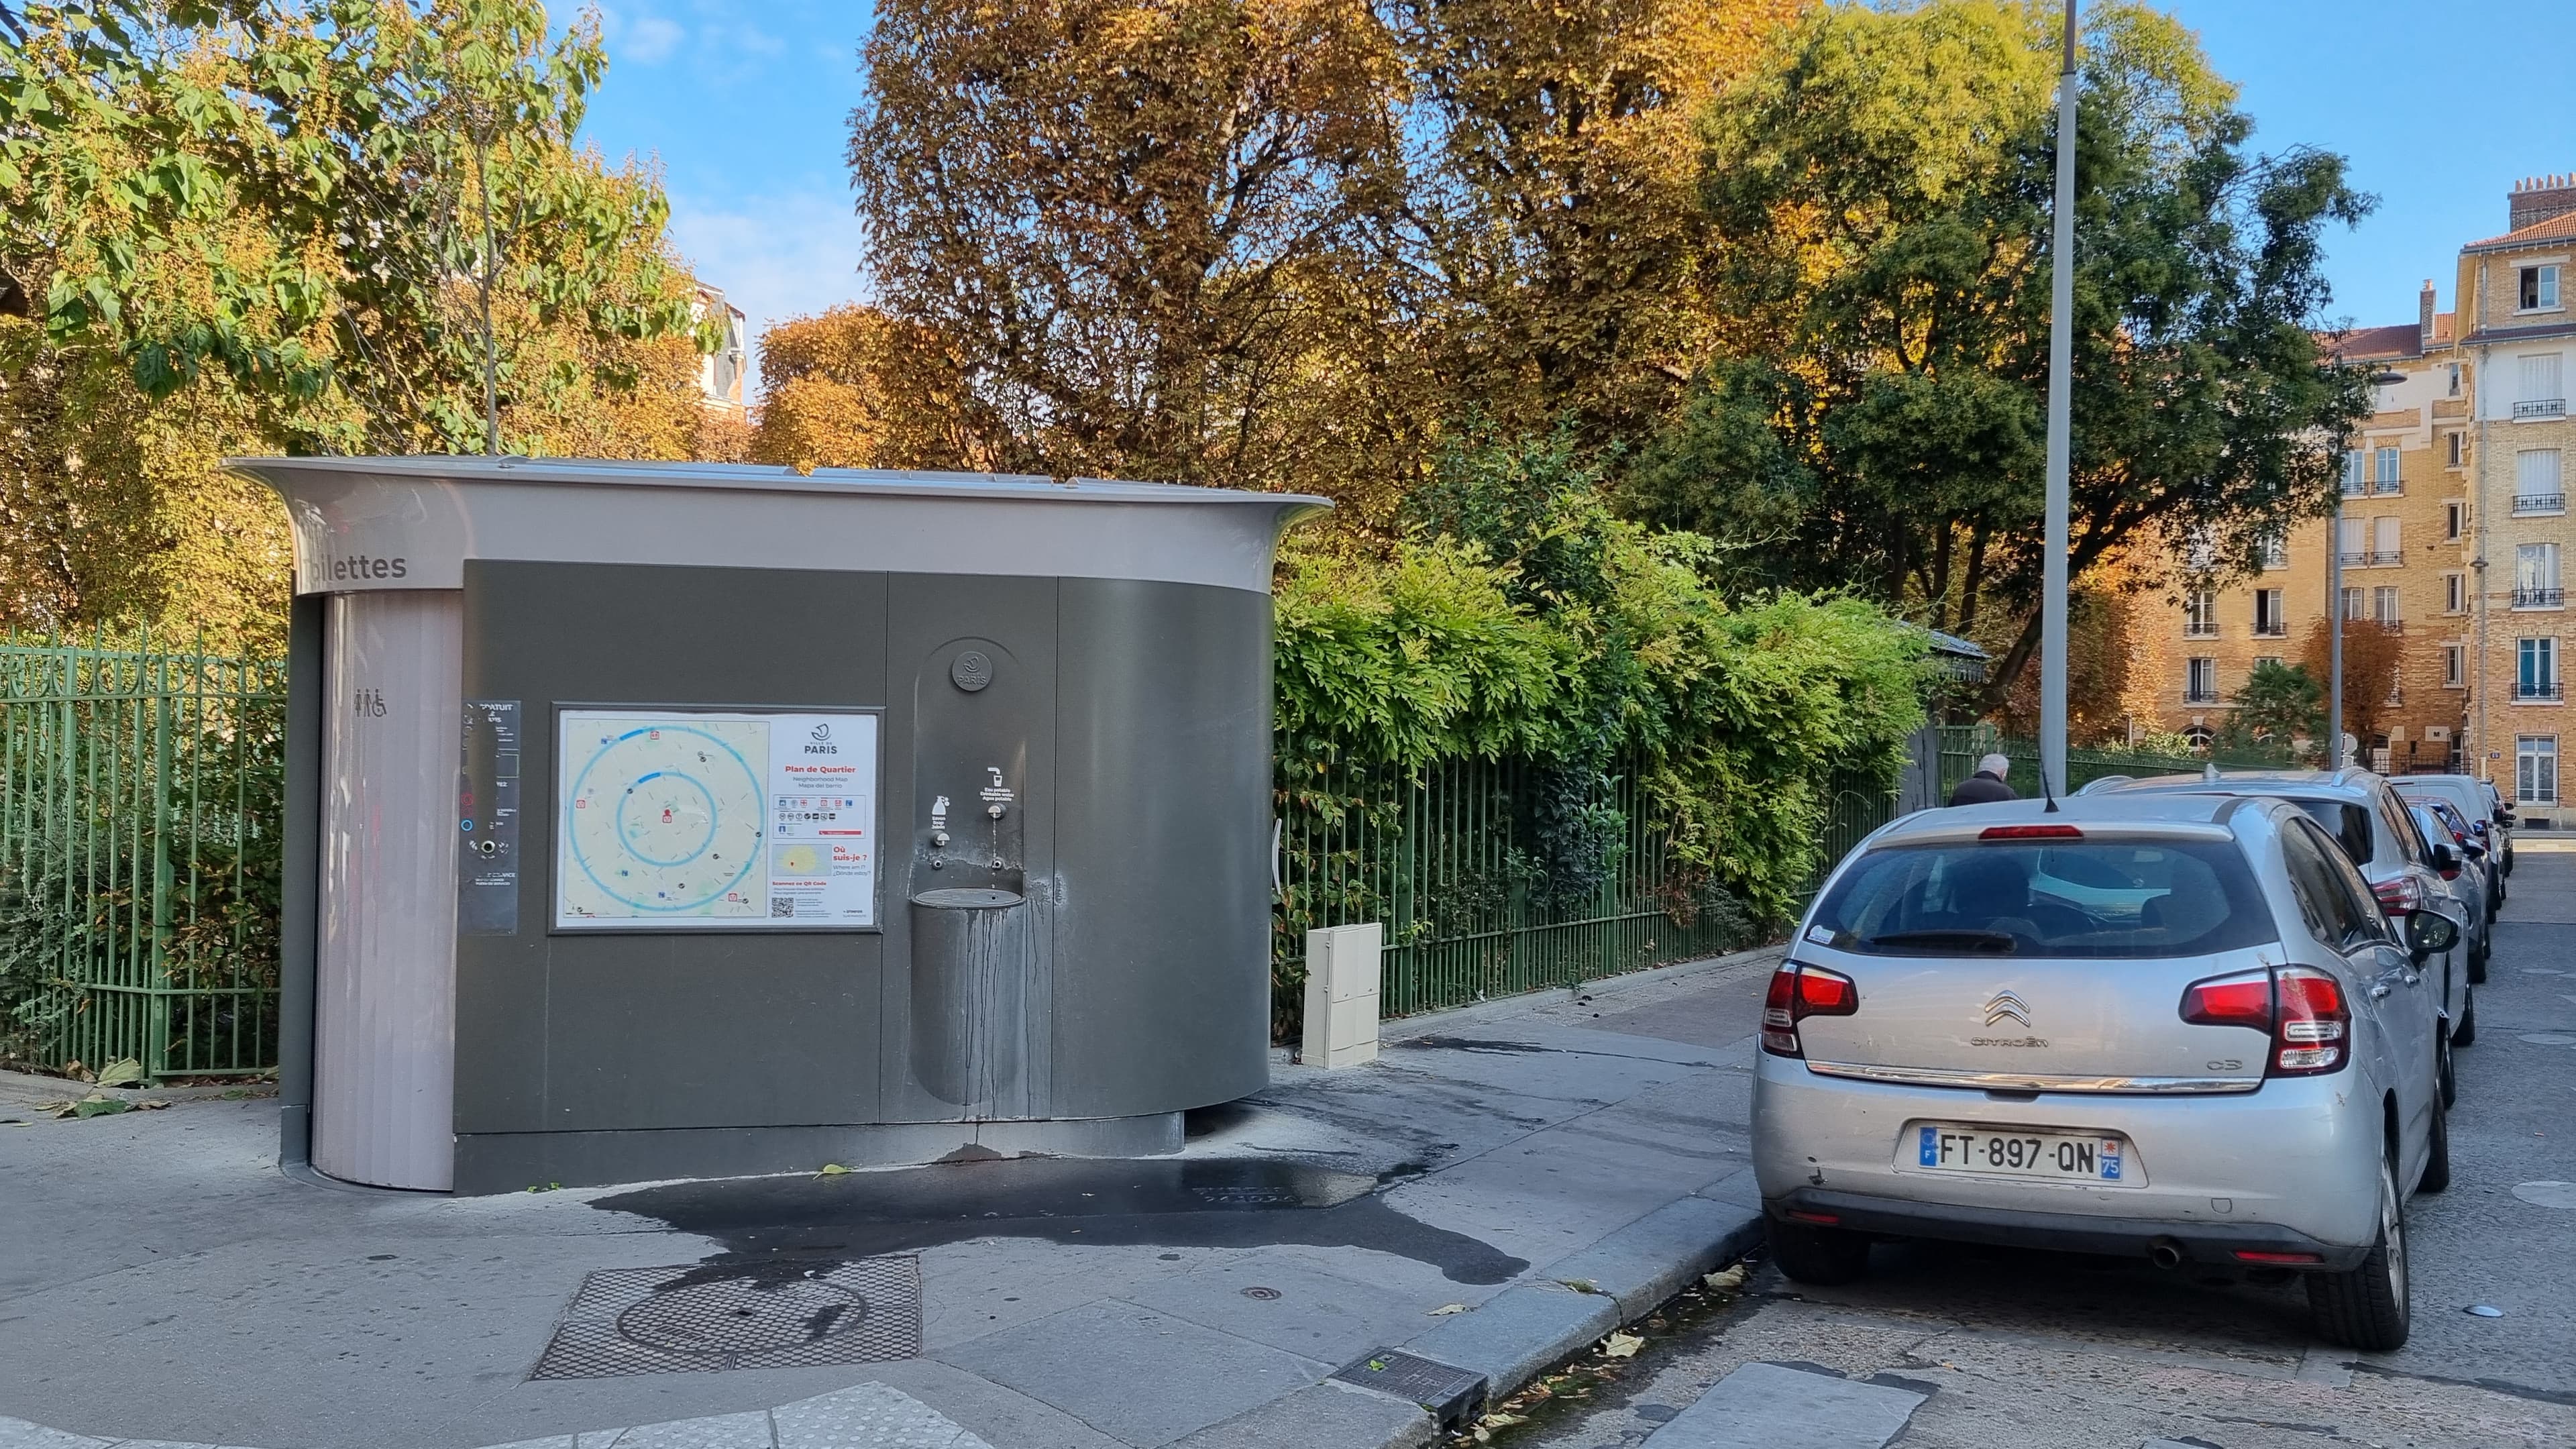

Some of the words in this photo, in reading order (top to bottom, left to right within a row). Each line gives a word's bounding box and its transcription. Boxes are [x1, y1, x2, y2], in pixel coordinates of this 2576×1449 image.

[958, 676, 987, 685] PARIS
[804, 745, 837, 754] PARIS
[833, 854, 861, 862] suis-je
[2207, 1059, 2243, 1070] C3
[1925, 1150, 1930, 1159] F
[1940, 1134, 2094, 1174] FT-897-QN
[2102, 1160, 2120, 1174] 75
